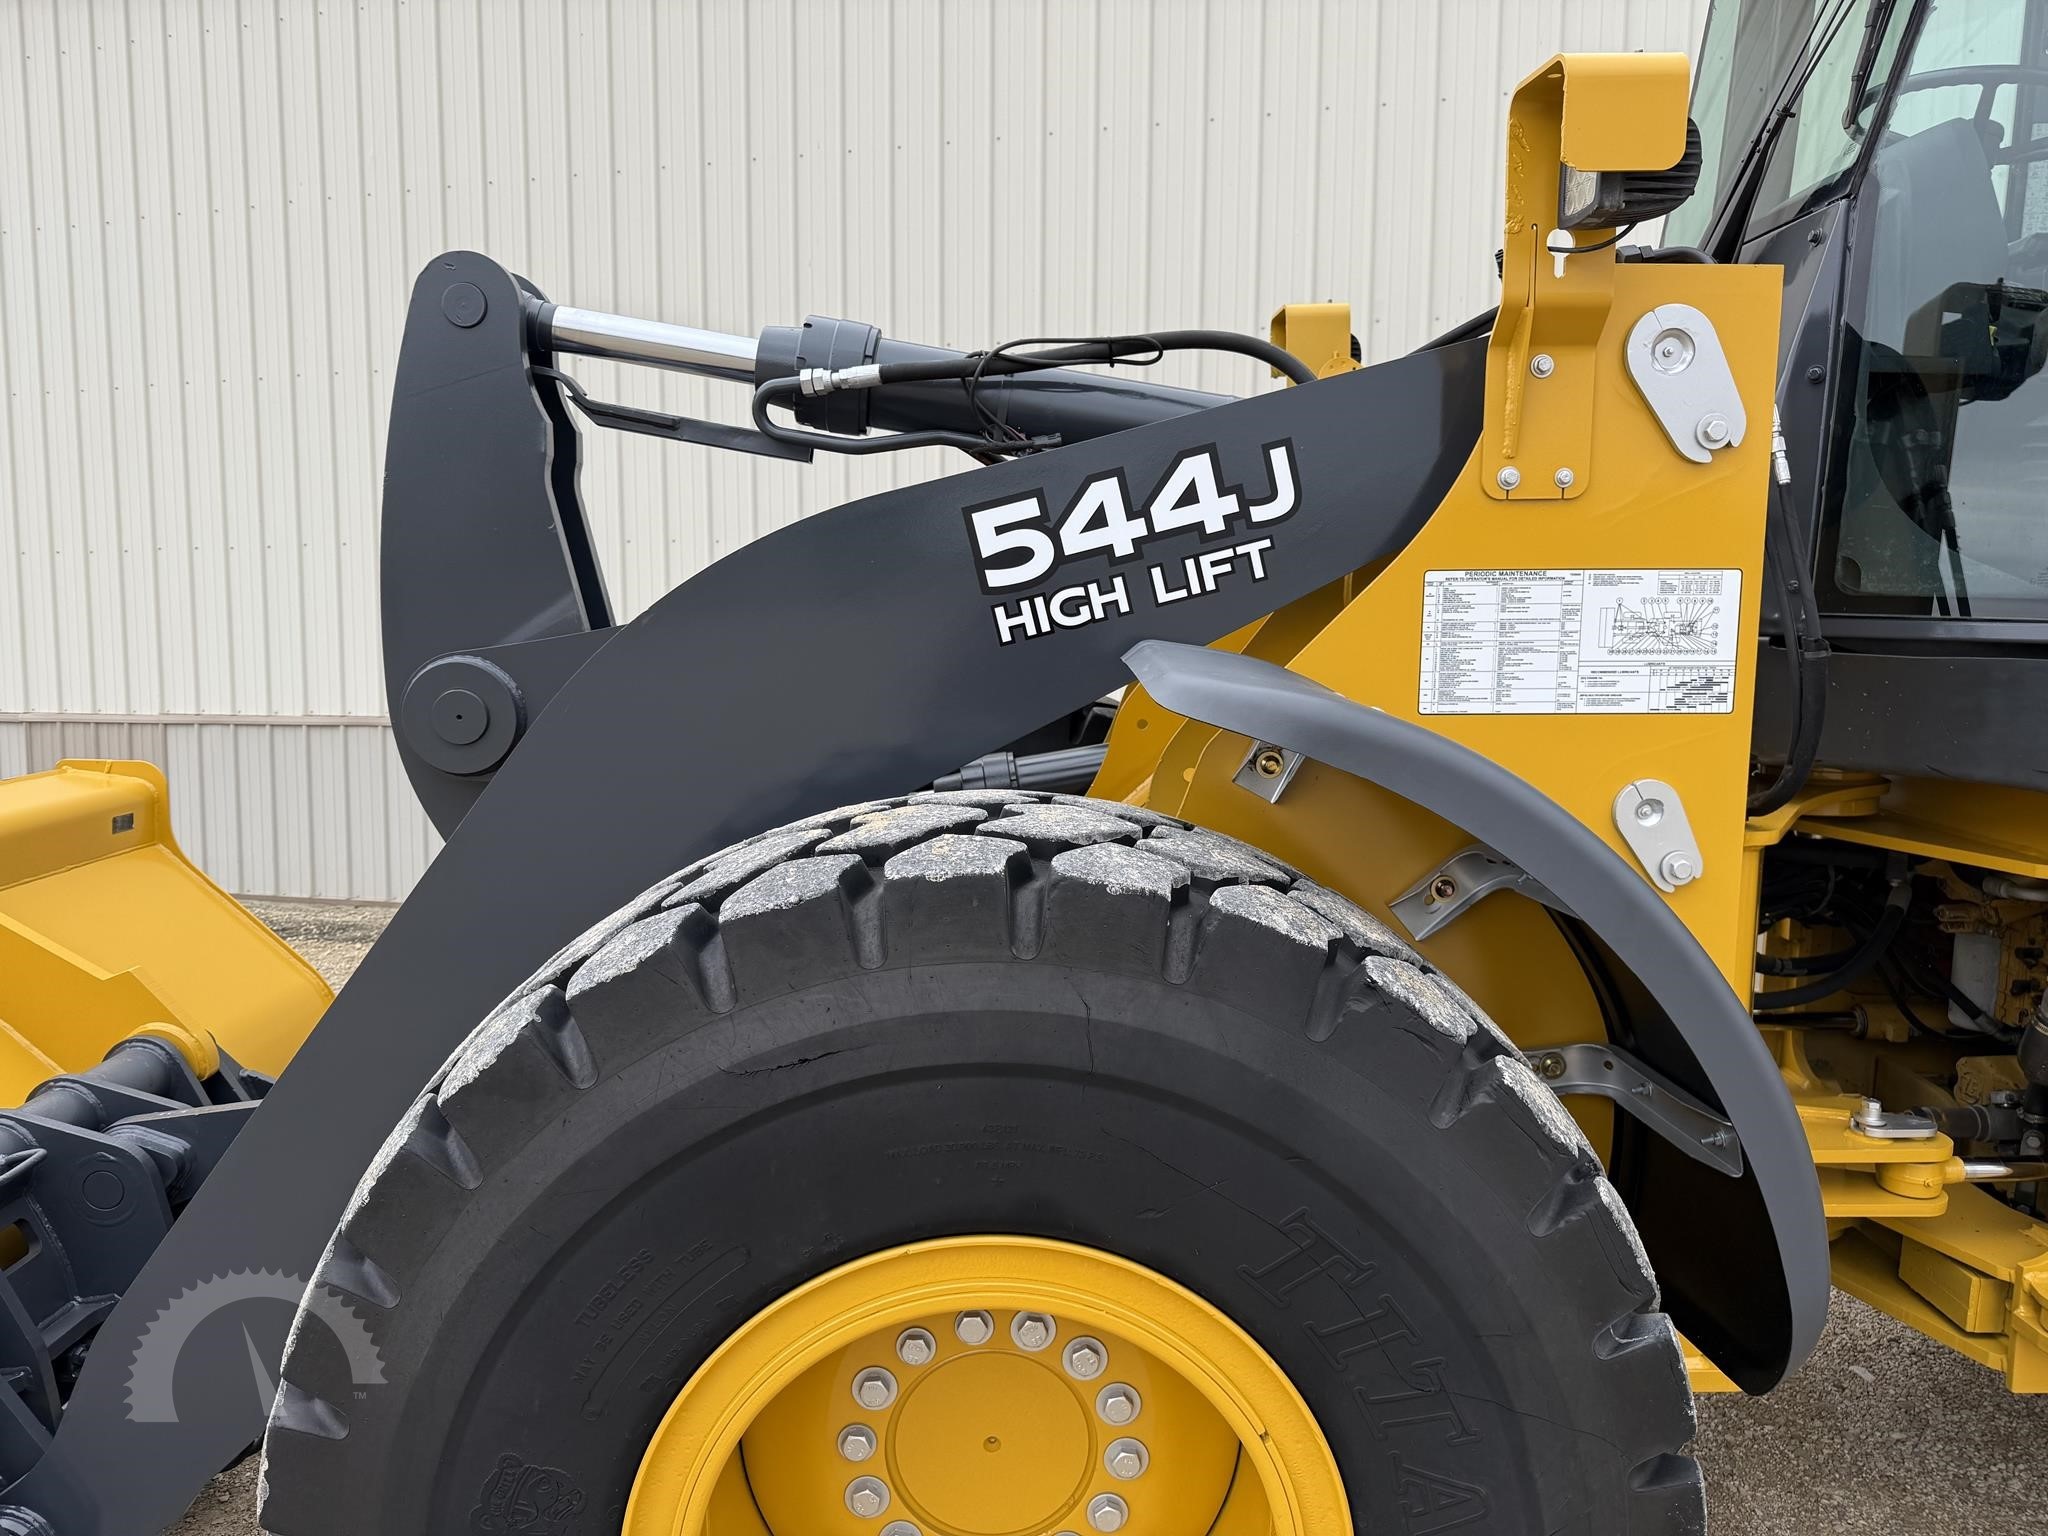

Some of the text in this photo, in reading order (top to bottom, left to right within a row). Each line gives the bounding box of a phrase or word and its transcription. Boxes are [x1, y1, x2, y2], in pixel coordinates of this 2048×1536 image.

[967, 442, 1298, 590] 544J
[993, 538, 1273, 645] HIGH LIFT
[574, 1247, 655, 1329] TUBELESS
[610, 1297, 644, 1329] USED
[672, 1238, 713, 1268] TUBE
